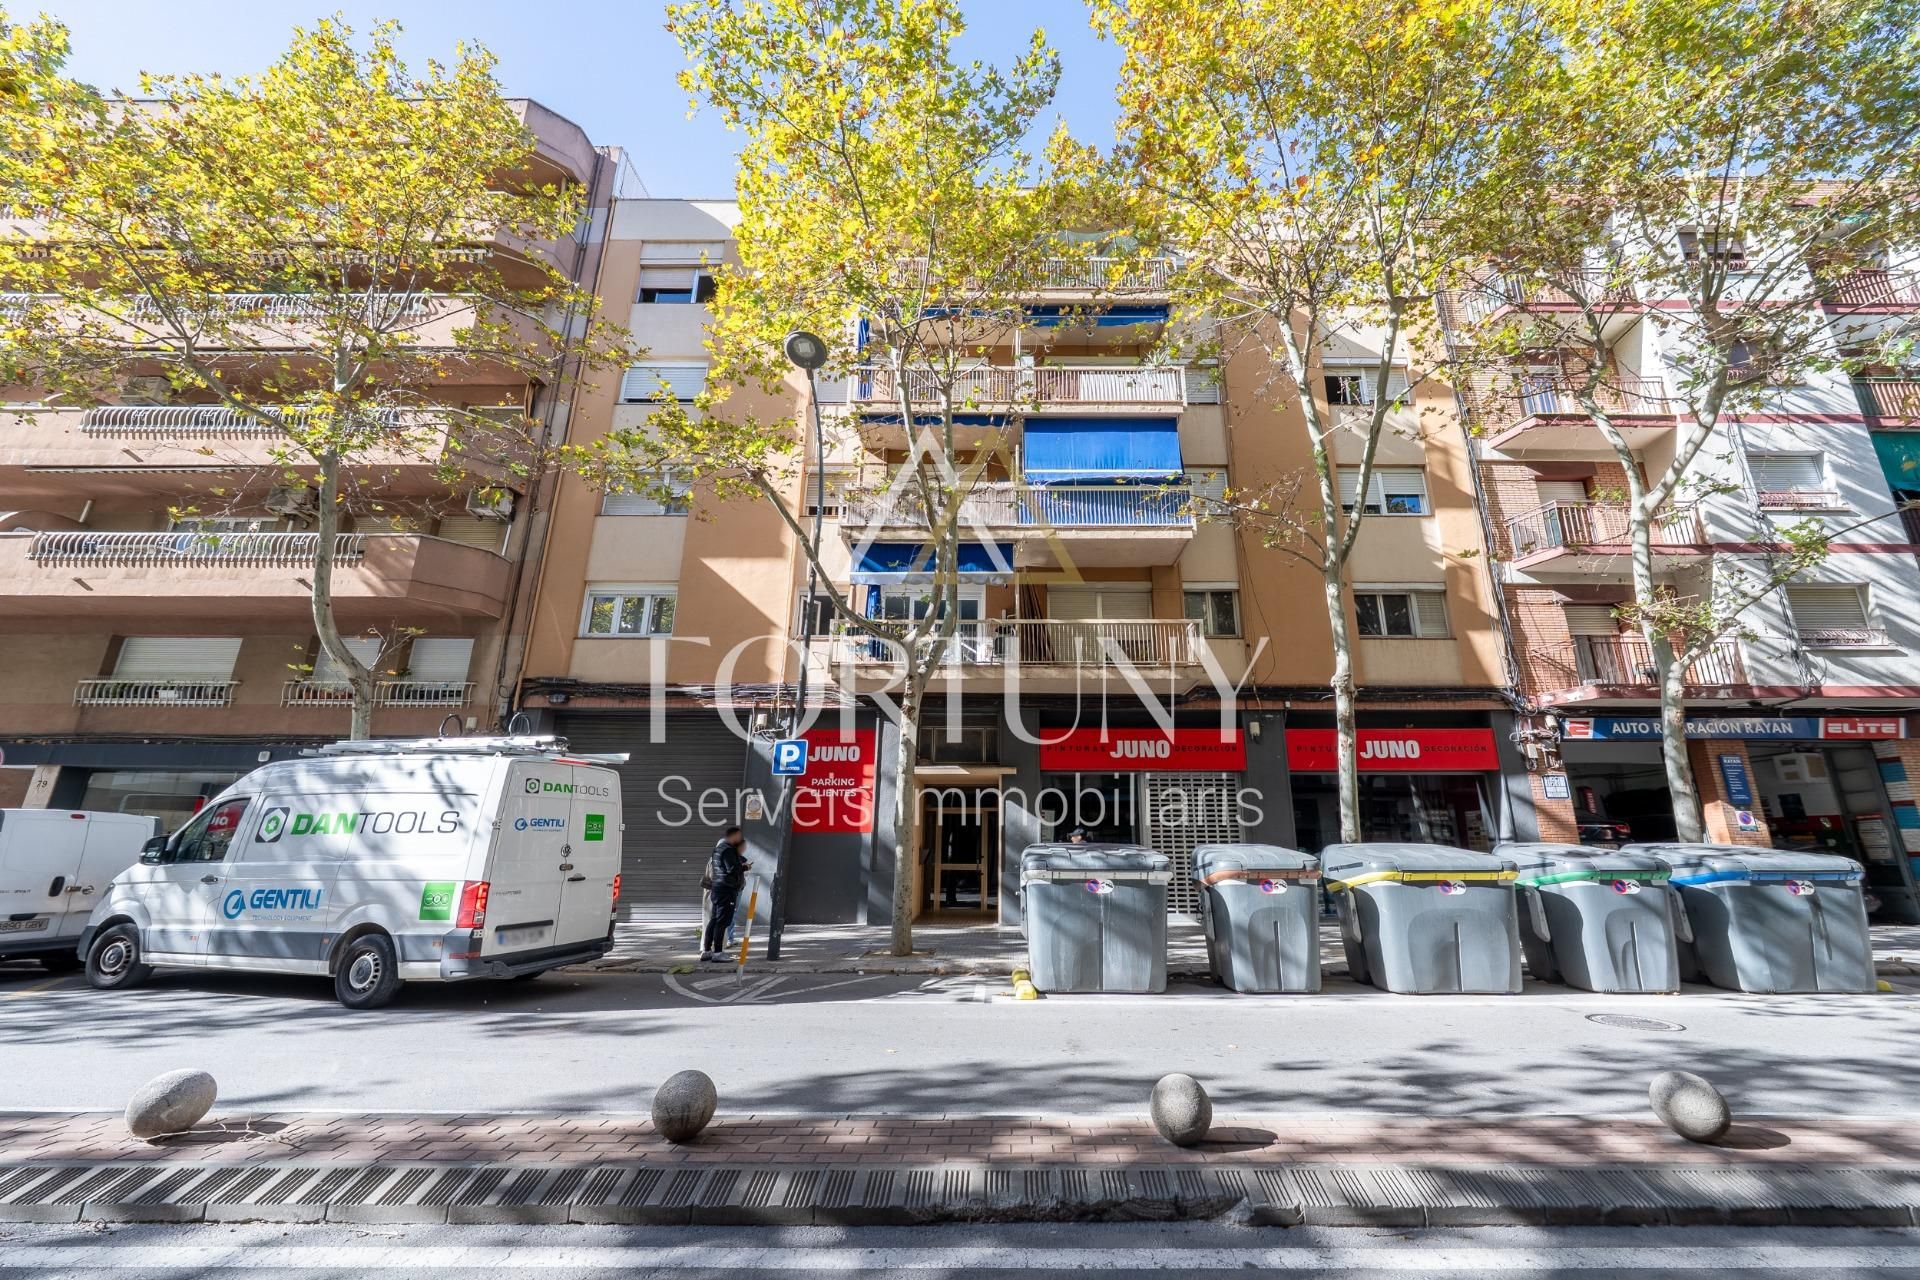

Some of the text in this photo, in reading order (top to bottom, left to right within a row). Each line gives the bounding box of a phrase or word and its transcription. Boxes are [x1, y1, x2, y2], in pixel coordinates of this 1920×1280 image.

[1612, 719, 1793, 734] AUTO RRACIÓN RAYAN
[780, 744, 800, 770] P
[808, 746, 860, 762] JUNO
[1109, 740, 1170, 759] JUNO
[1174, 744, 1237, 752] DECORACIÓN
[1360, 740, 1420, 759] JUNO
[1424, 744, 1488, 752] DECORACIÓN
[543, 782, 609, 796] DANTOOLS
[811, 778, 855, 786] PARKING
[810, 789, 857, 797] CLIENTES
[290, 811, 460, 835] DANTOOLS
[530, 818, 565, 828] GENTILI
[249, 889, 322, 909] GENTILI
